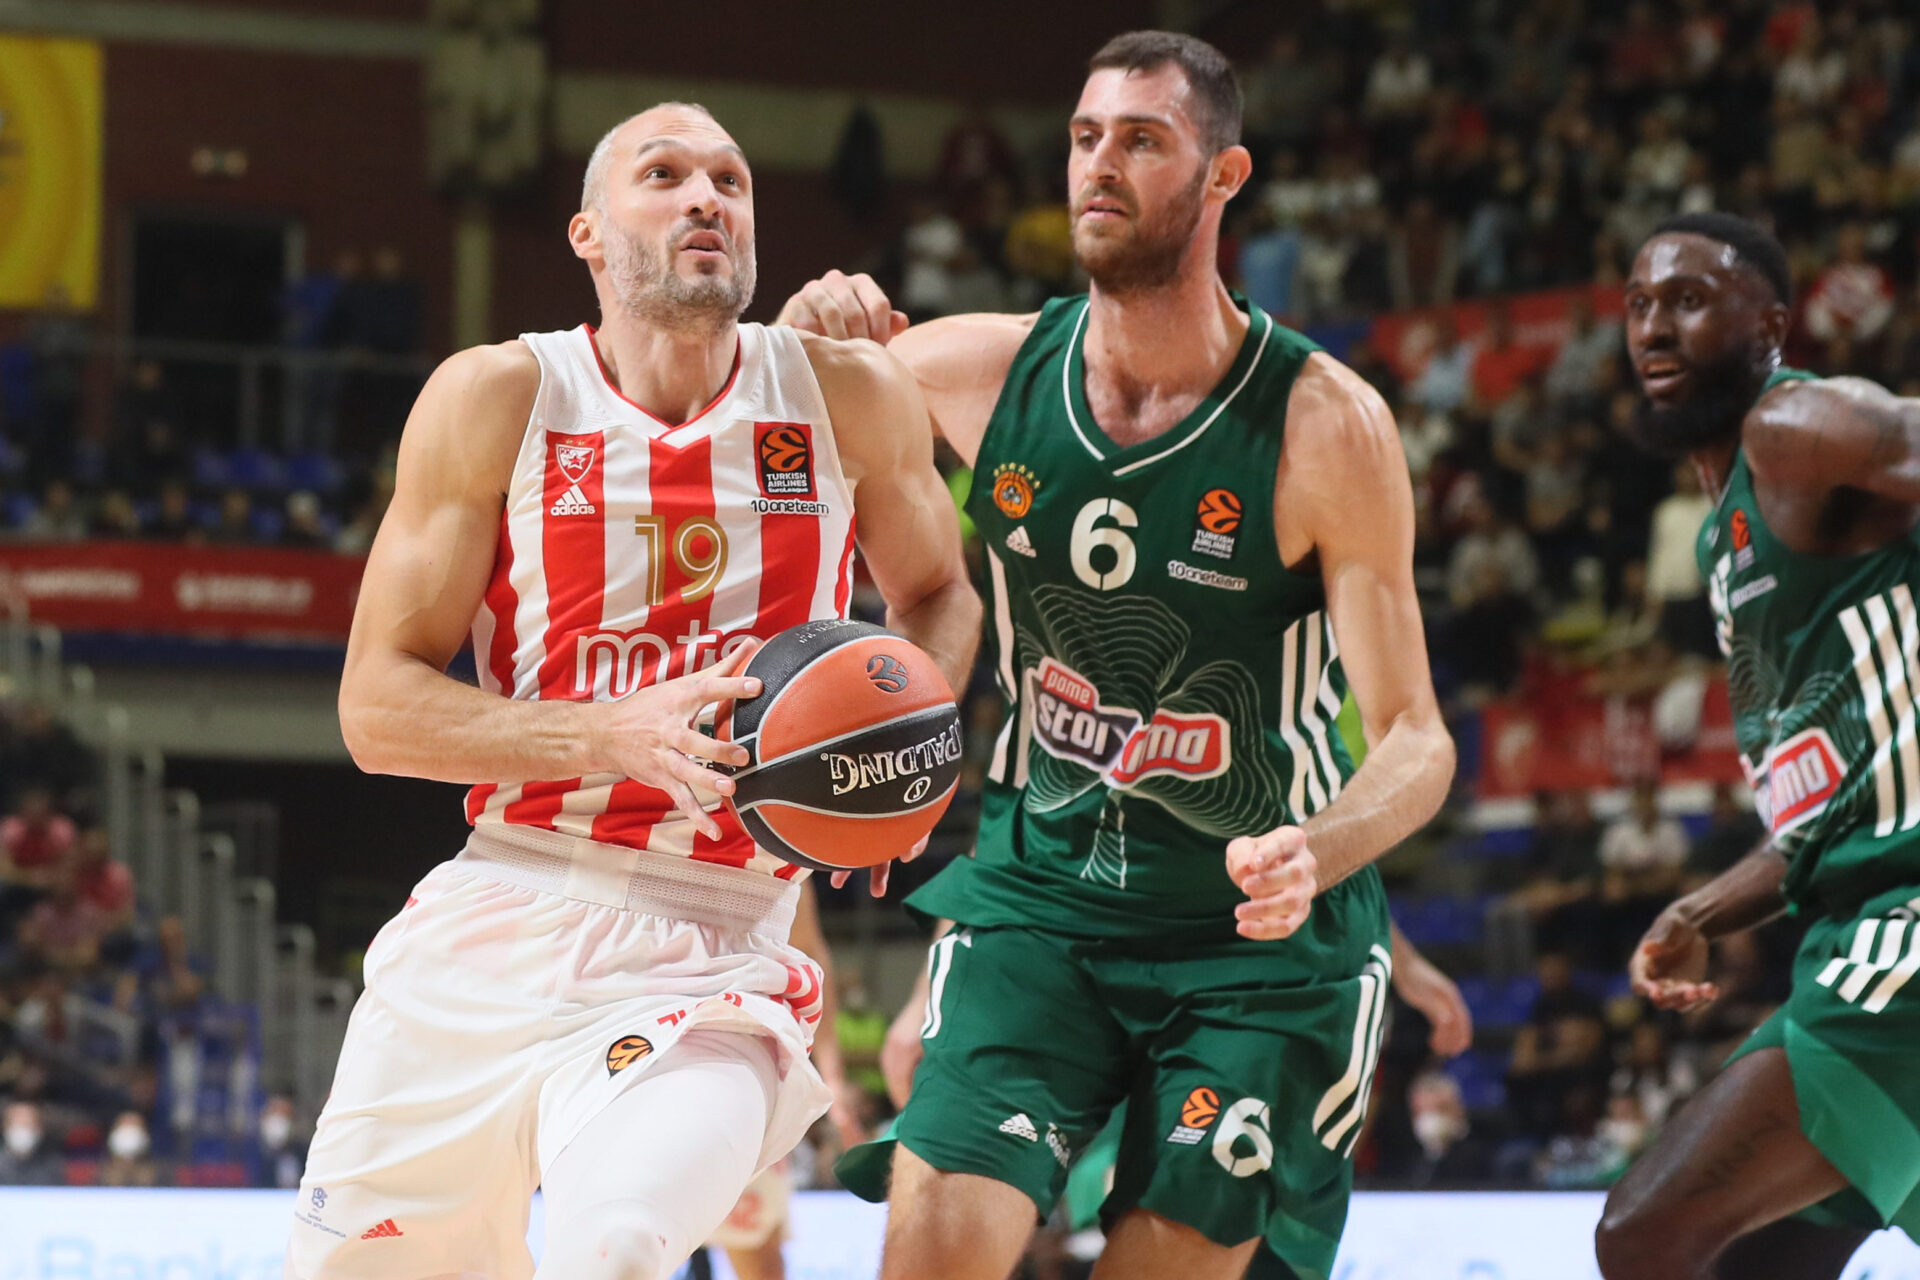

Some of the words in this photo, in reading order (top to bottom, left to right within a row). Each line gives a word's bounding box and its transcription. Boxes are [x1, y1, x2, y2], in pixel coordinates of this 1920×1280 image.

[766, 472, 807, 481] TURKISH
[767, 480, 808, 488] AIRLINES
[550, 504, 596, 516] adidas
[635, 514, 729, 605] 19
[1070, 497, 1138, 591] 6
[1212, 1097, 1274, 1178] 6
